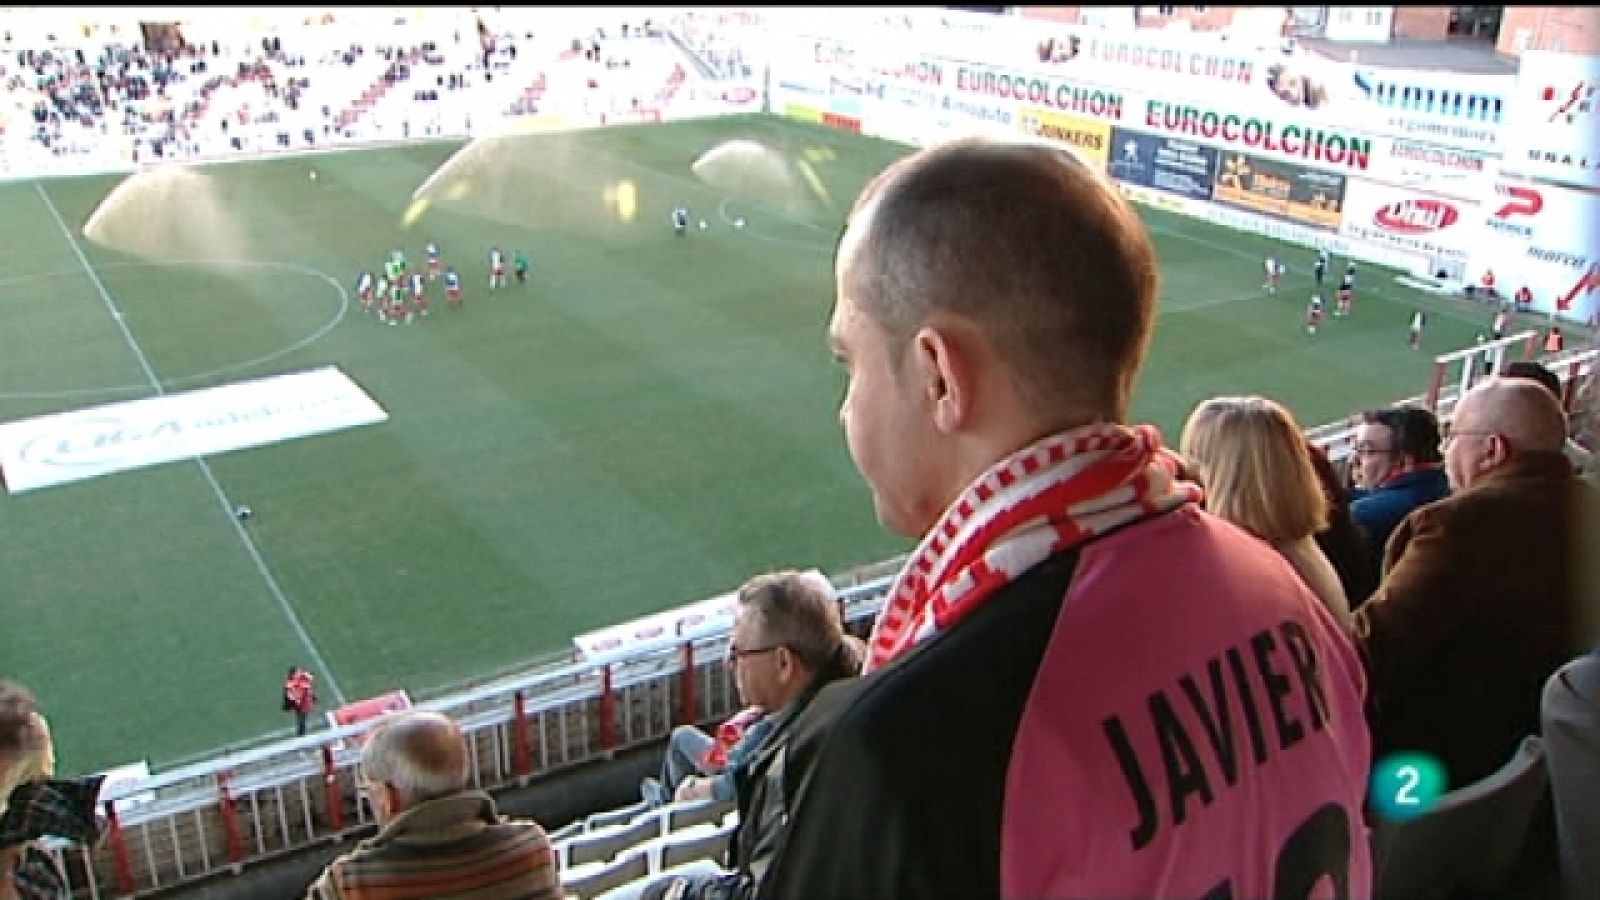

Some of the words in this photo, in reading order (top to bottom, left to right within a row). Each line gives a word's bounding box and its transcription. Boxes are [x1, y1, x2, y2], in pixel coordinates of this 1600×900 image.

[956, 65, 1124, 120] EUROCOLCHON
[1144, 98, 1372, 170] EUROCOLCHON
[1102, 620, 1330, 850] JAVIER
